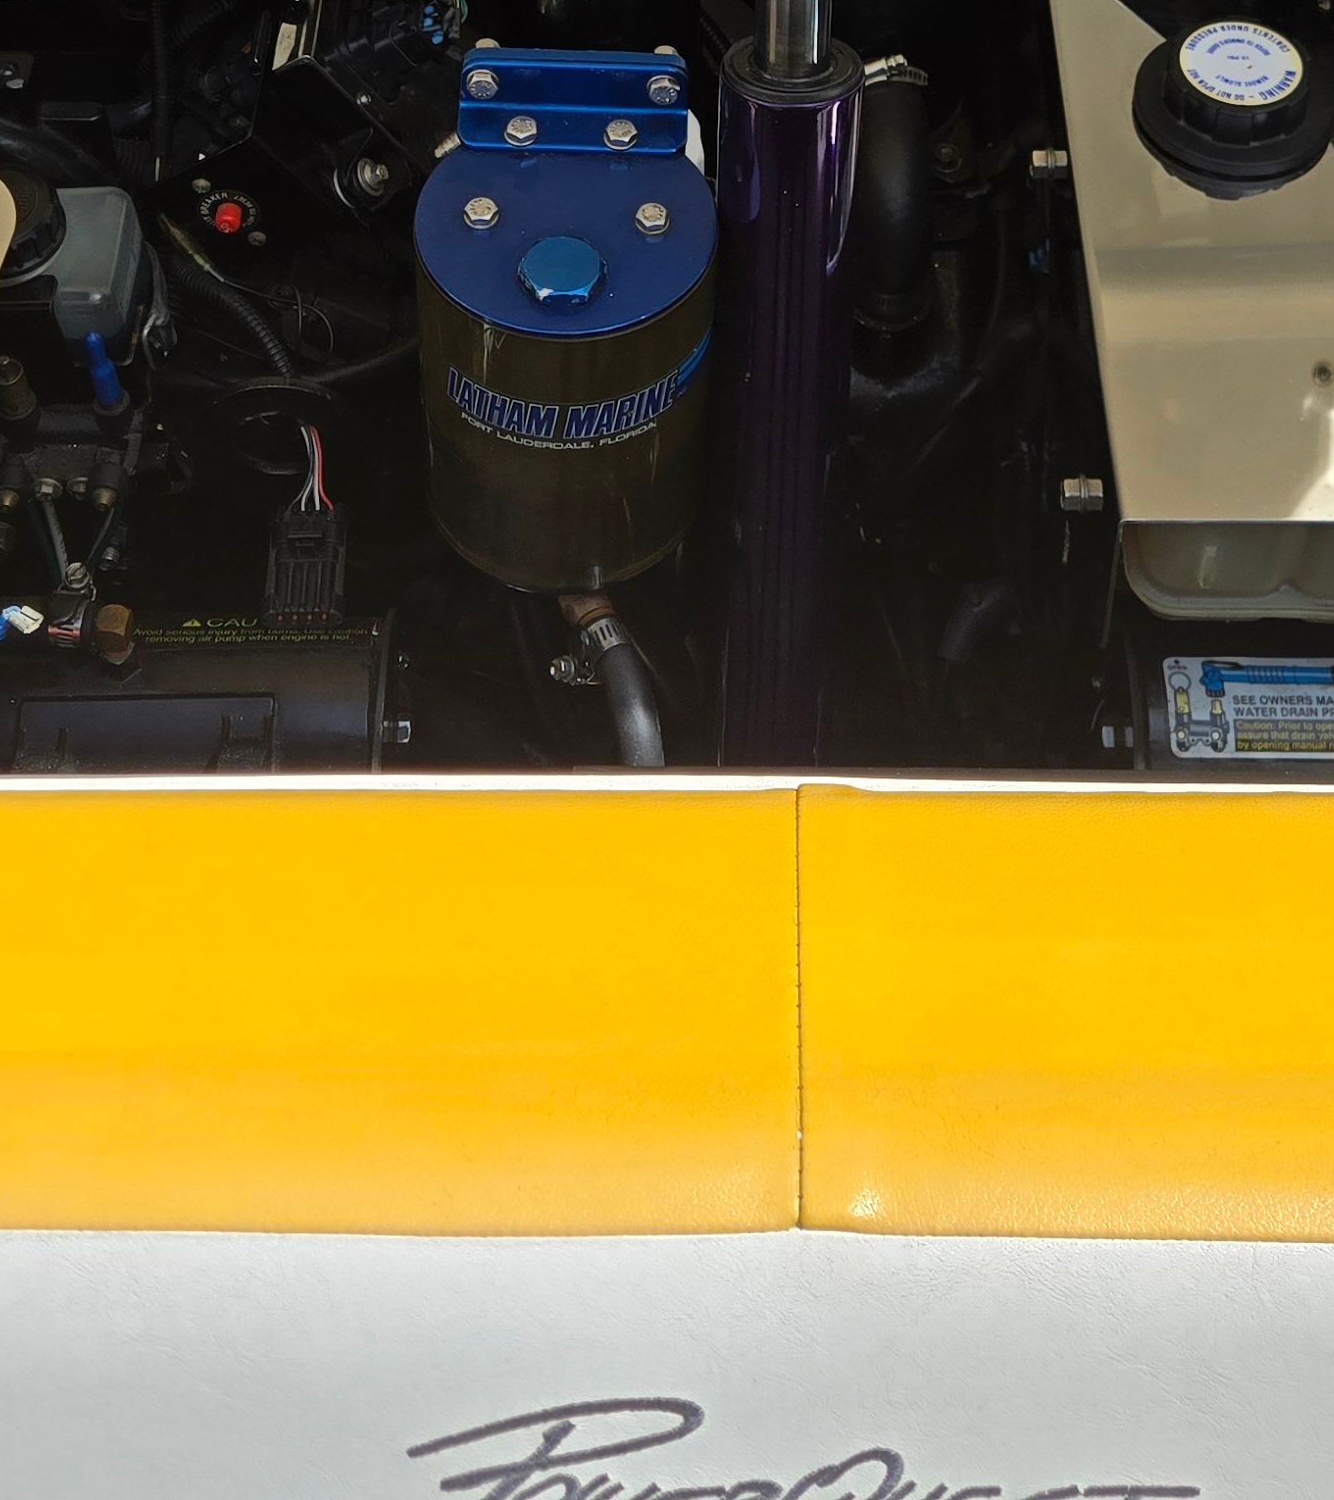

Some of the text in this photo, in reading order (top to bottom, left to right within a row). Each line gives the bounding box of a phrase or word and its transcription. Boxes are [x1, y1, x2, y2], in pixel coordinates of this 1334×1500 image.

[1259, 70, 1297, 100] WARNING
[1216, 90, 1232, 100] NOT
[446, 366, 680, 439] LATHAM MARINE
[461, 411, 493, 433] FORT
[599, 421, 657, 446] FLORIDA
[146, 636, 195, 644] removing
[1233, 695, 1256, 705] SEE
[1259, 695, 1313, 706] OWNERS
[1234, 706, 1277, 717] WATER
[1281, 707, 1317, 717] DRAIN
[1278, 721, 1300, 729] Prior
[1303, 721, 1313, 729] to
[1271, 731, 1289, 739] that
[1291, 731, 1316, 739] drain
[1237, 740, 1249, 750] by
[1251, 740, 1289, 750] opening
[1291, 740, 1326, 749] manual
